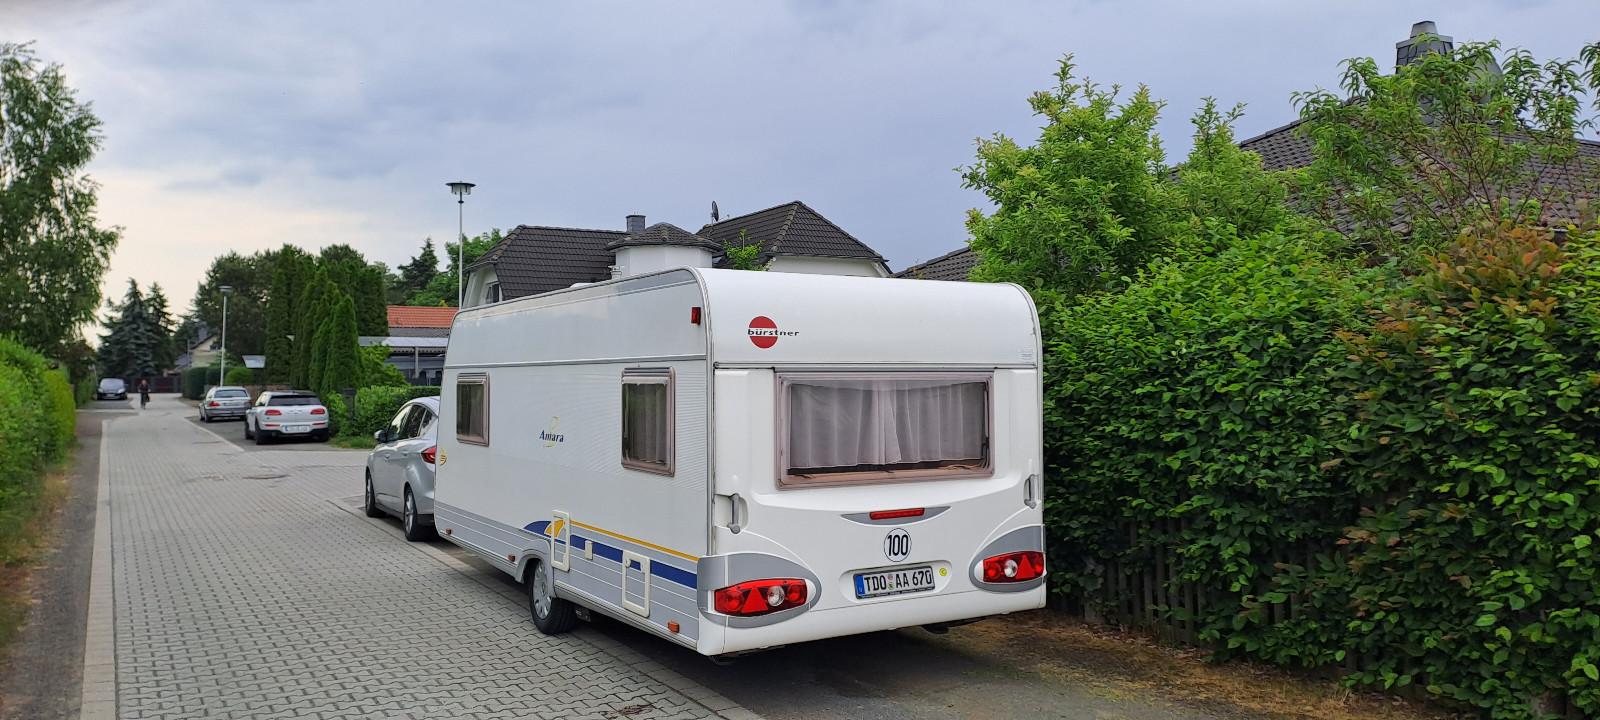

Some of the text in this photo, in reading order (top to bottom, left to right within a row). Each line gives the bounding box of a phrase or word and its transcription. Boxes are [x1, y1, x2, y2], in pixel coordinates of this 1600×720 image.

[747, 328, 800, 337] bürstner
[539, 429, 564, 443] Amara
[887, 534, 909, 556] 100
[864, 575, 887, 592] TDO
[895, 572, 910, 589] AA
[912, 569, 933, 586] 670
